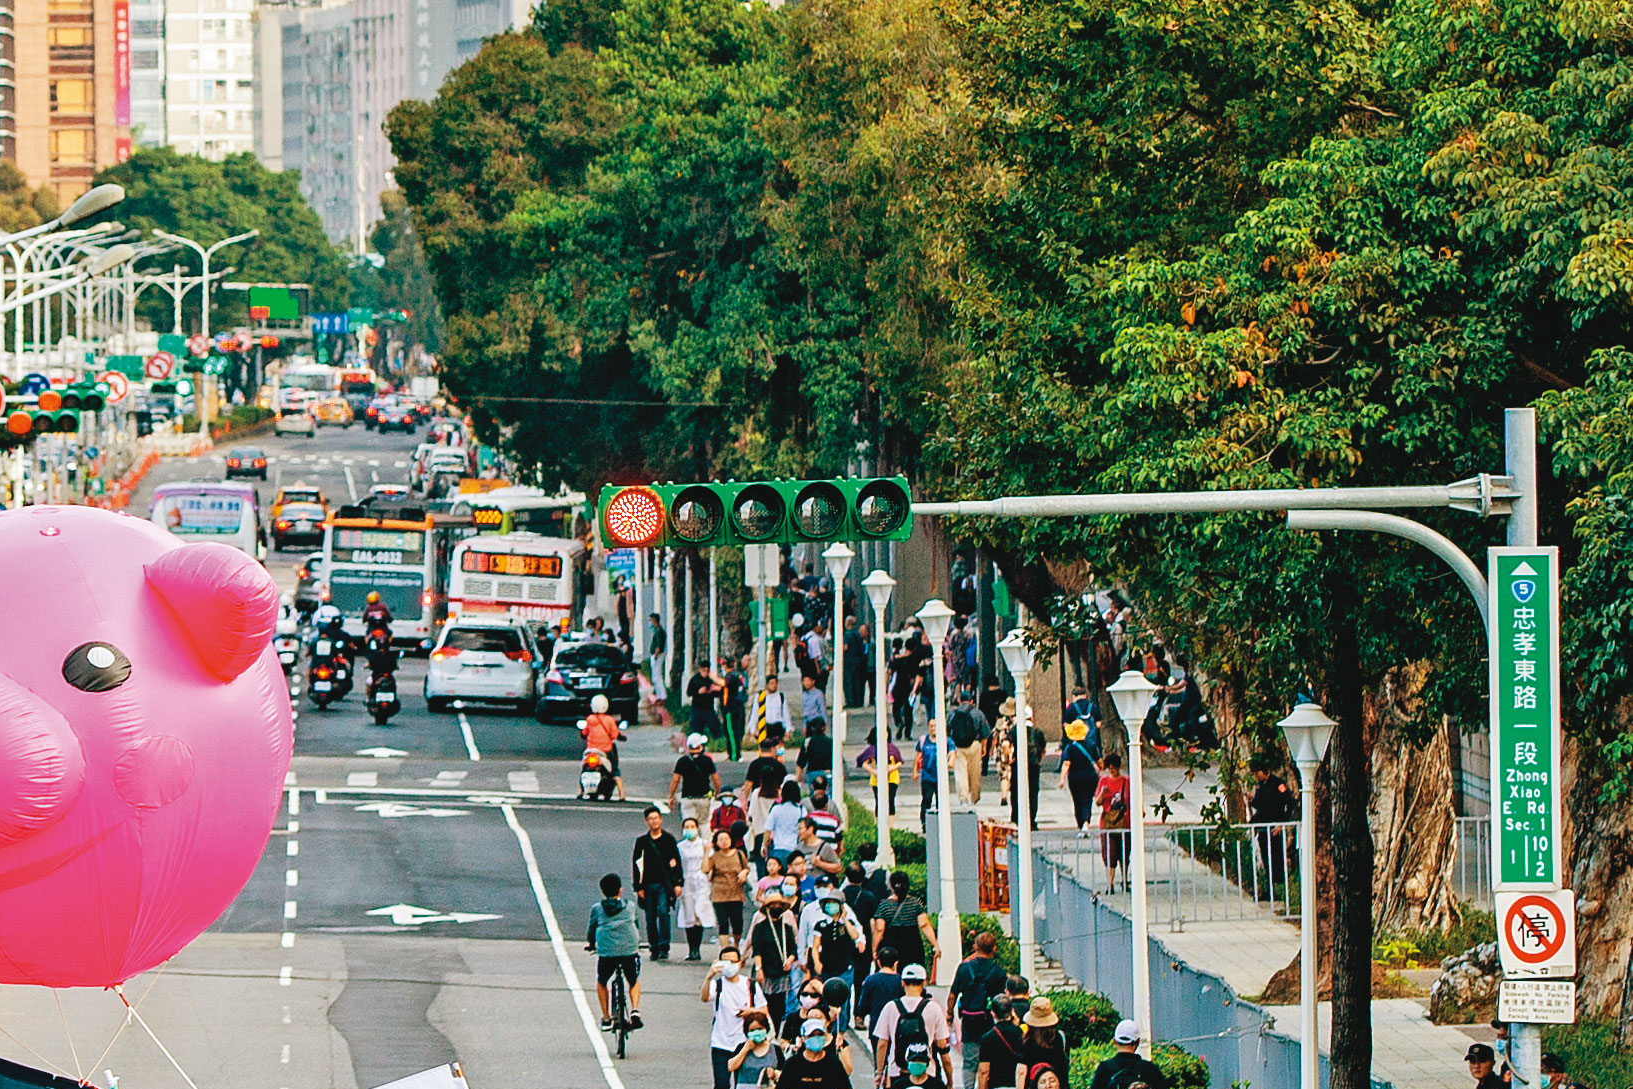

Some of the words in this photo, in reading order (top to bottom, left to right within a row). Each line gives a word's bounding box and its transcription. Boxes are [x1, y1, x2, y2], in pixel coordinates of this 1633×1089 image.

[1519, 583, 1529, 595] 5
[1512, 606, 1538, 765] 忠孝東路一段
[1506, 768, 1548, 786] Zhong
[1509, 785, 1541, 799] Xiao
[1540, 817, 1546, 831] 1
[1510, 849, 1516, 865] 1
[1517, 913, 1550, 948] 停
